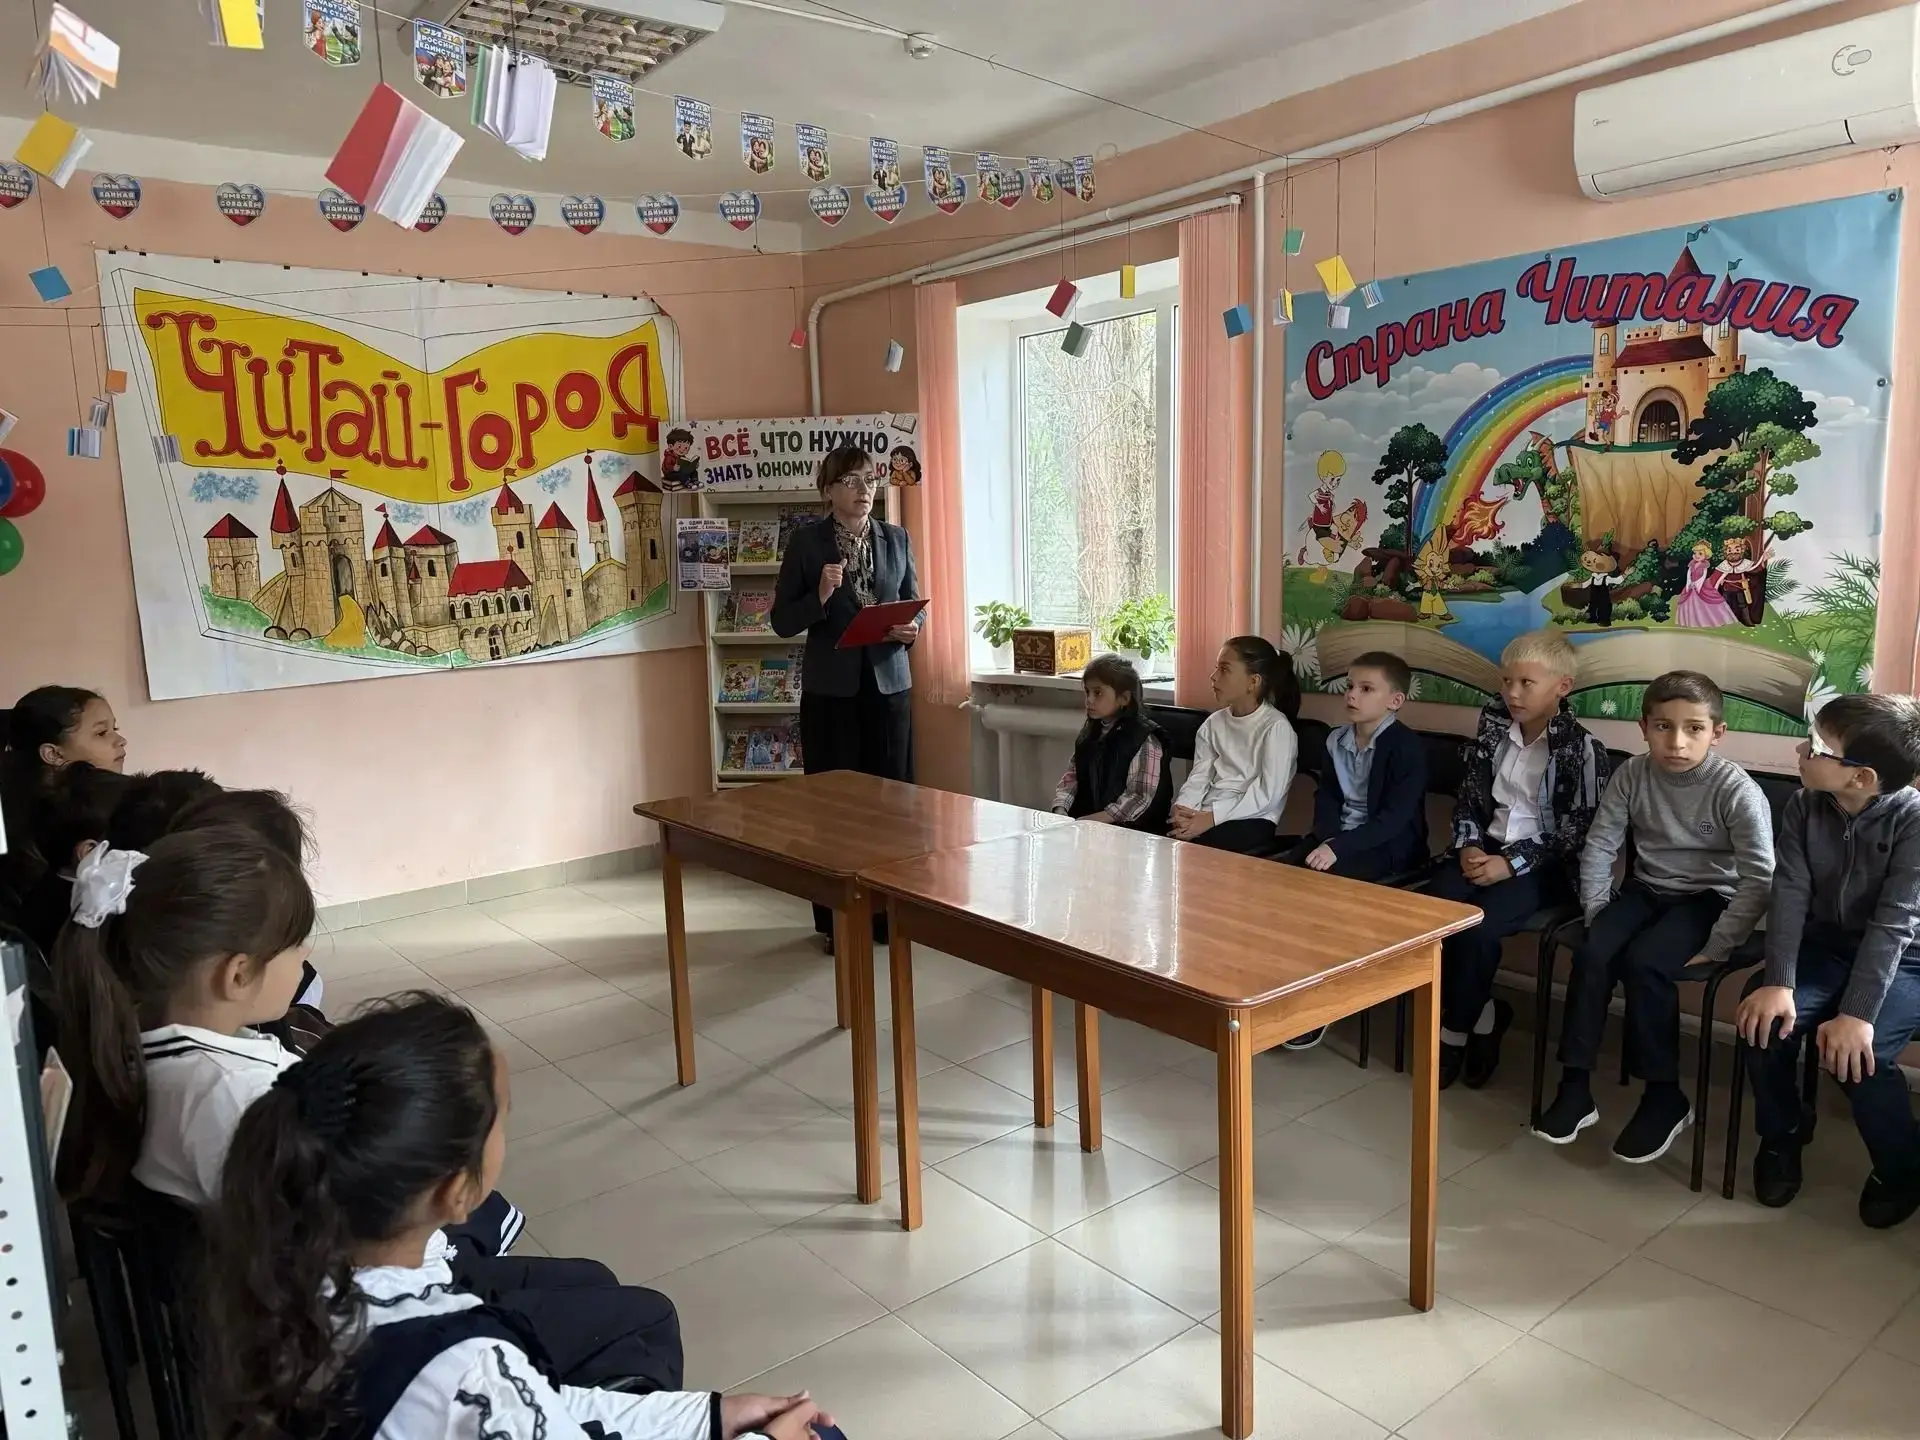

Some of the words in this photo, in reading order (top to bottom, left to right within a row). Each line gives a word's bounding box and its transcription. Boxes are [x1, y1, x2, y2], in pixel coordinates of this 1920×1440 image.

[1306, 289, 1506, 400] Страна
[1516, 257, 1859, 349] Читалия
[704, 427, 759, 461] ВСЁ,
[761, 430, 803, 454] ЧТО
[809, 430, 889, 454] НУЖНО
[703, 465, 753, 485] ЗНАТЬ
[757, 460, 812, 478] ЮНОМУ
